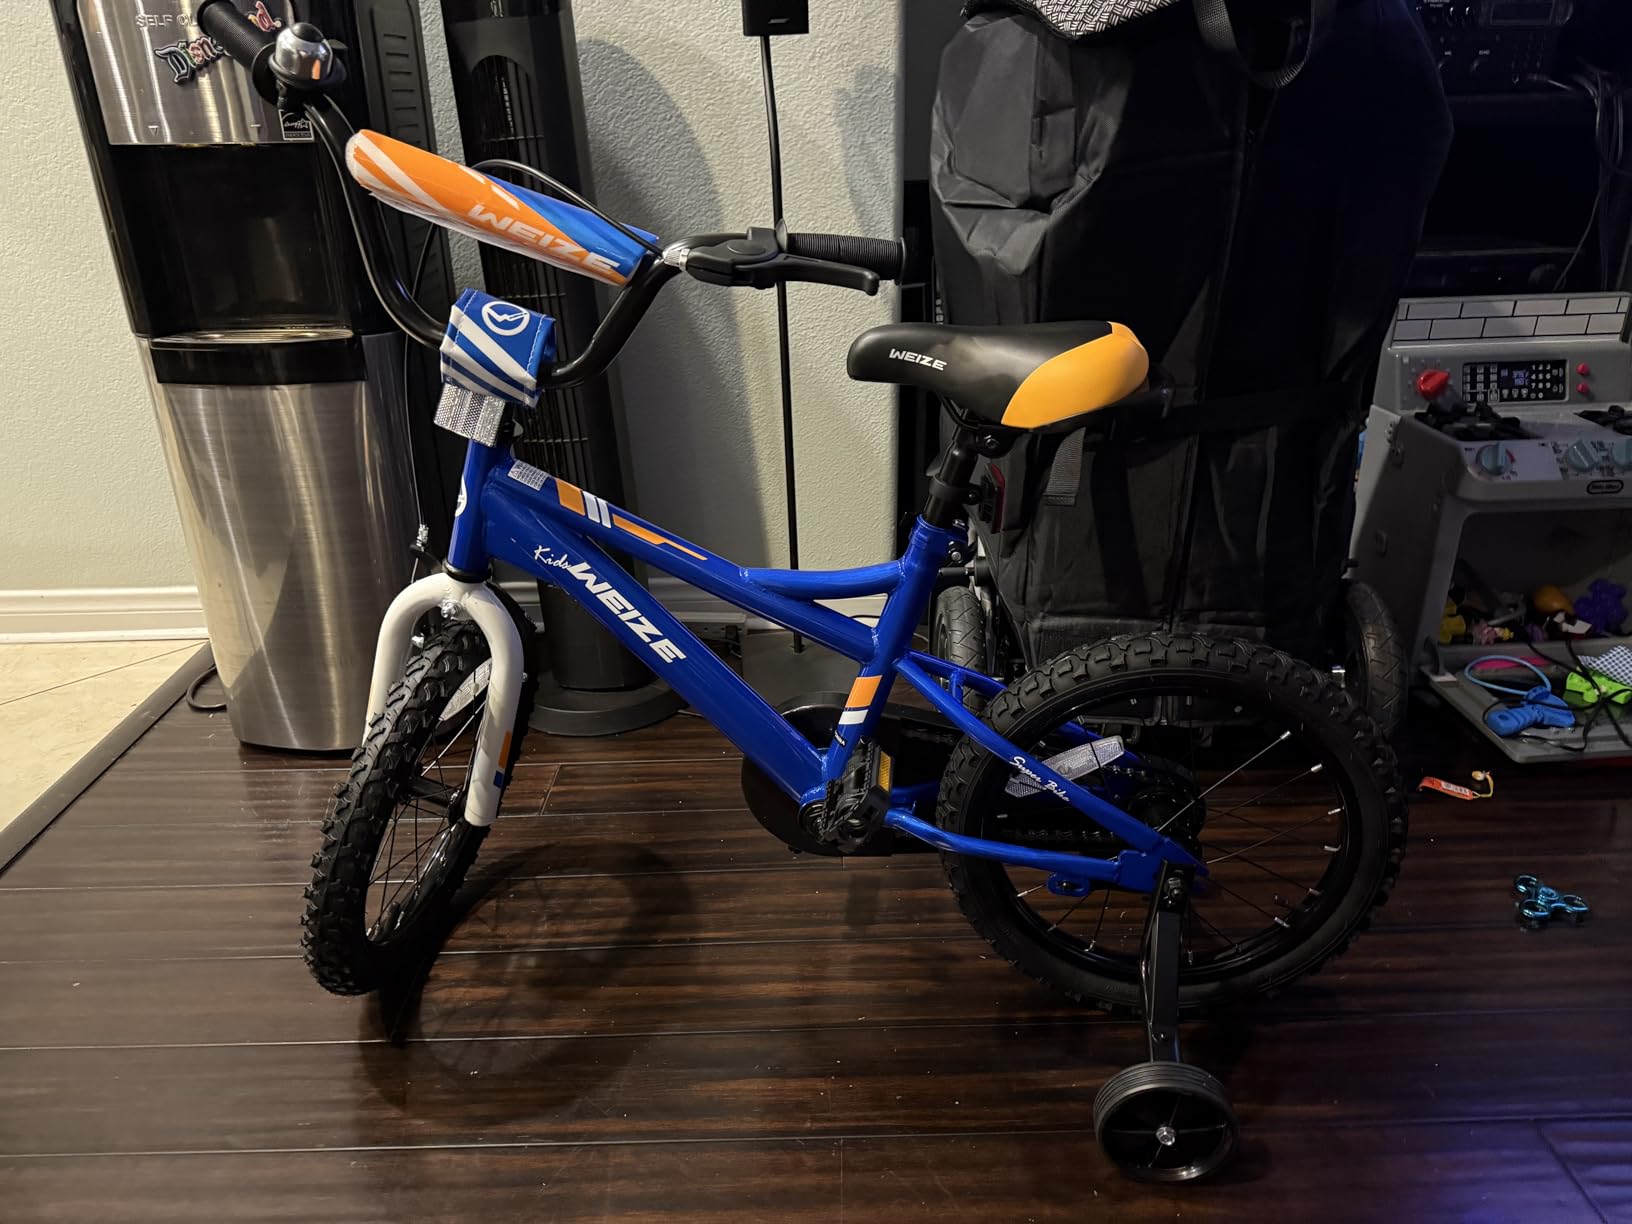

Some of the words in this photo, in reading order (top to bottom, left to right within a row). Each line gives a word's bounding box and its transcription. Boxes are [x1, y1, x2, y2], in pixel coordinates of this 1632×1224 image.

[135, 14, 173, 27] SELF
[467, 204, 620, 274] WEIZE
[889, 348, 947, 371] WEIZE
[567, 562, 687, 664] WEIZE
